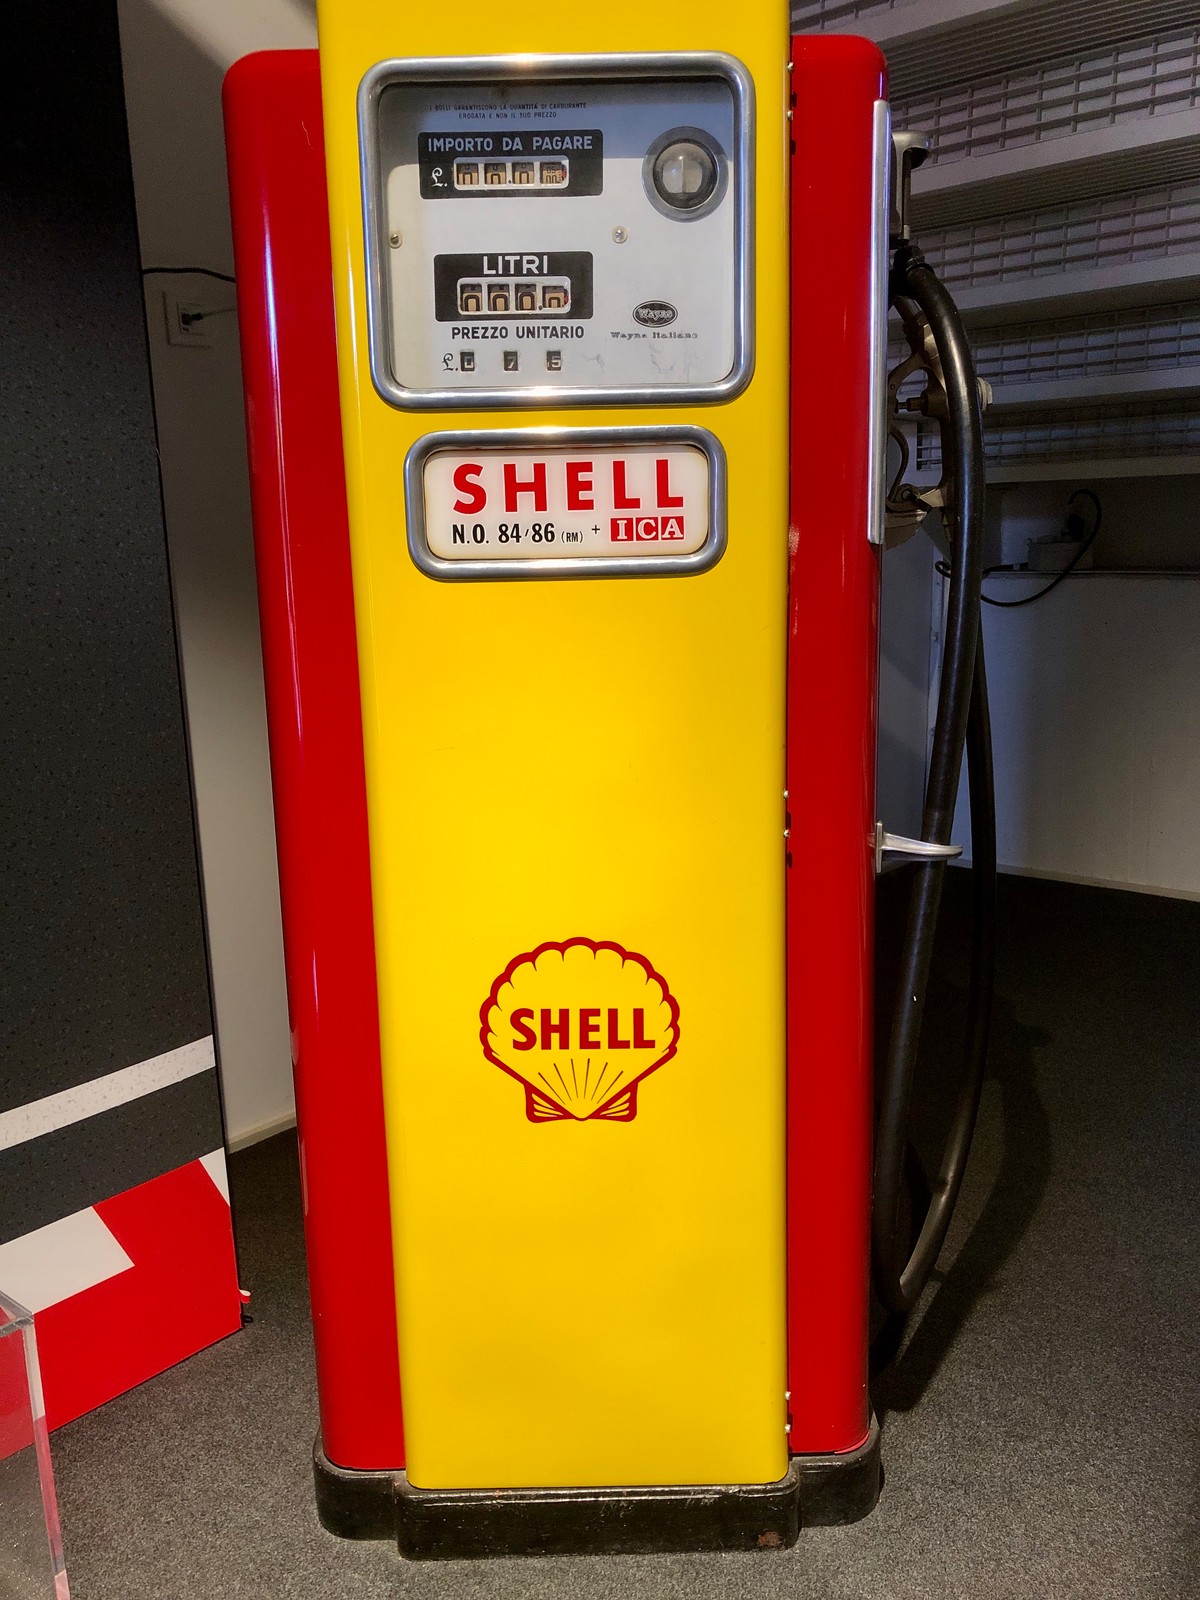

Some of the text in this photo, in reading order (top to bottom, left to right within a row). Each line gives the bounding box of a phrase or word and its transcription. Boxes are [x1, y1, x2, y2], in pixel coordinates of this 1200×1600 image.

[428, 136, 593, 152] IMPORTO DA PAGARE
[483, 255, 549, 275] LITRI
[452, 325, 585, 340] PREZZO UNITARIO
[452, 459, 685, 515] SHELL
[452, 523, 490, 545] N.O.
[561, 531, 584, 543] (RM)
[613, 518, 685, 541] ICA
[509, 1007, 656, 1052] SHELL
